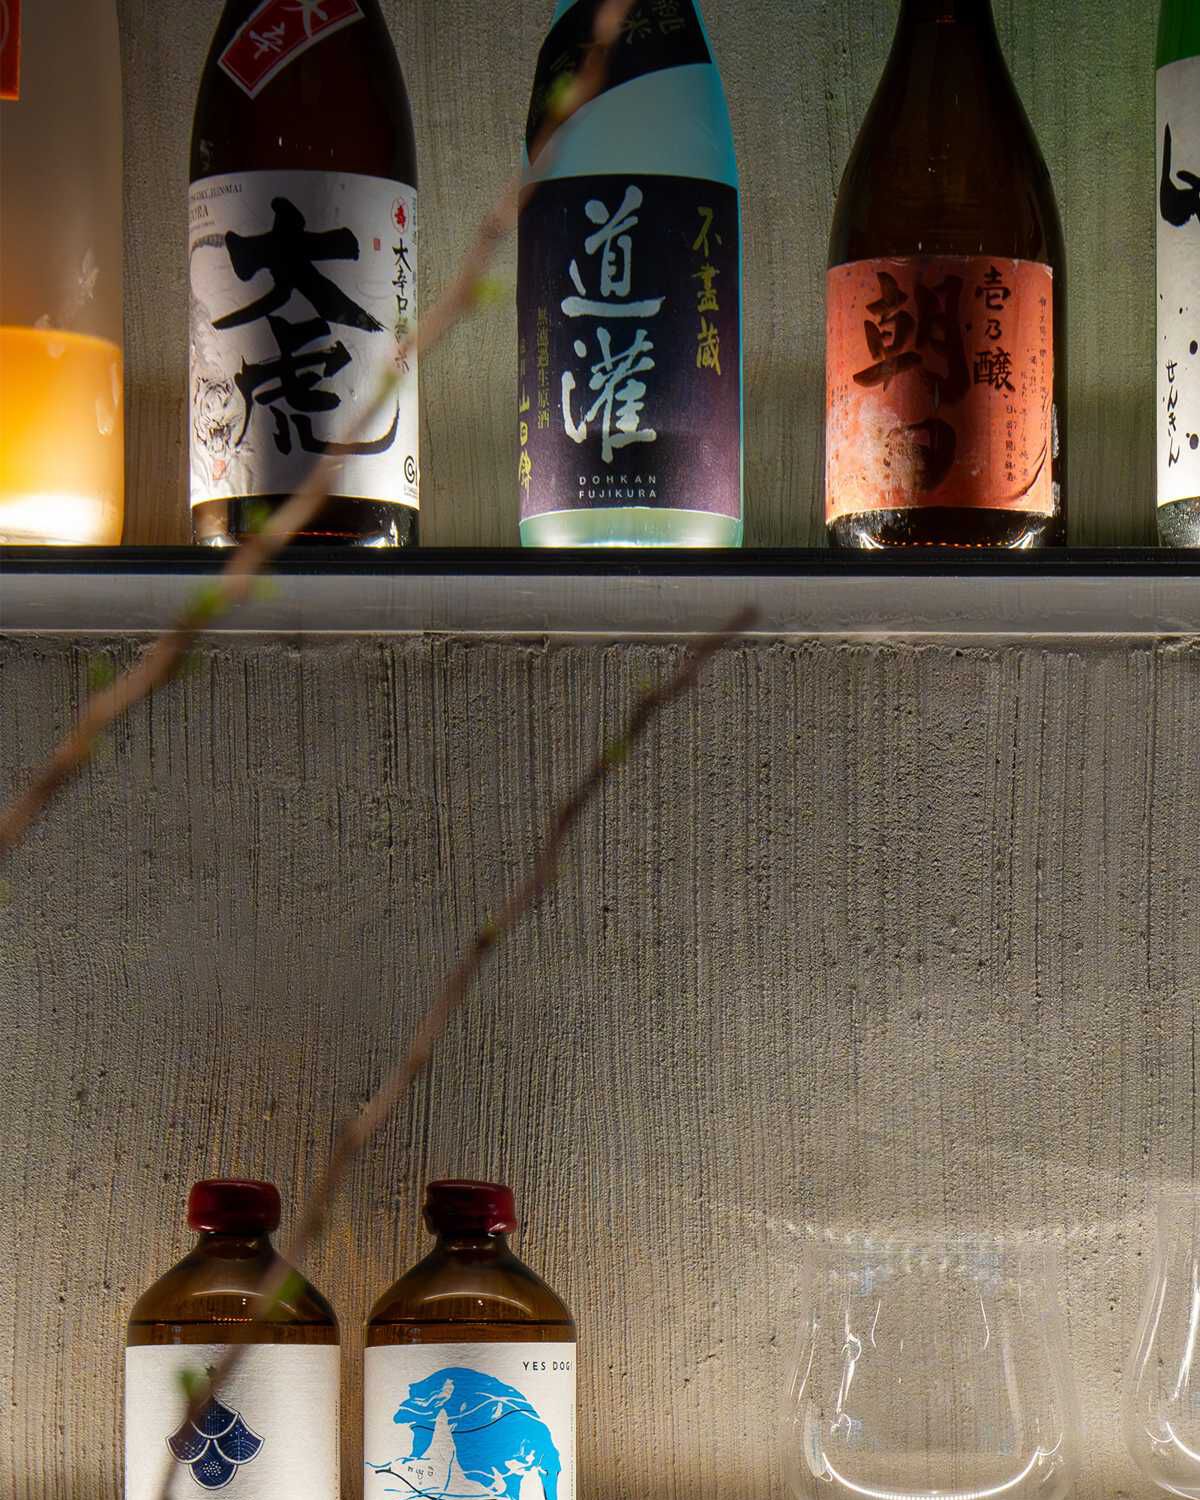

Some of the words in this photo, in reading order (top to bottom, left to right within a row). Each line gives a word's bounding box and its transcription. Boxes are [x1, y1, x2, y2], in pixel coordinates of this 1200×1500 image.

[561, 185, 666, 464] 道灌
[579, 475, 656, 485] DOHKAN
[579, 488, 657, 499] FUJIKURA
[522, 1361, 546, 1371] YES
